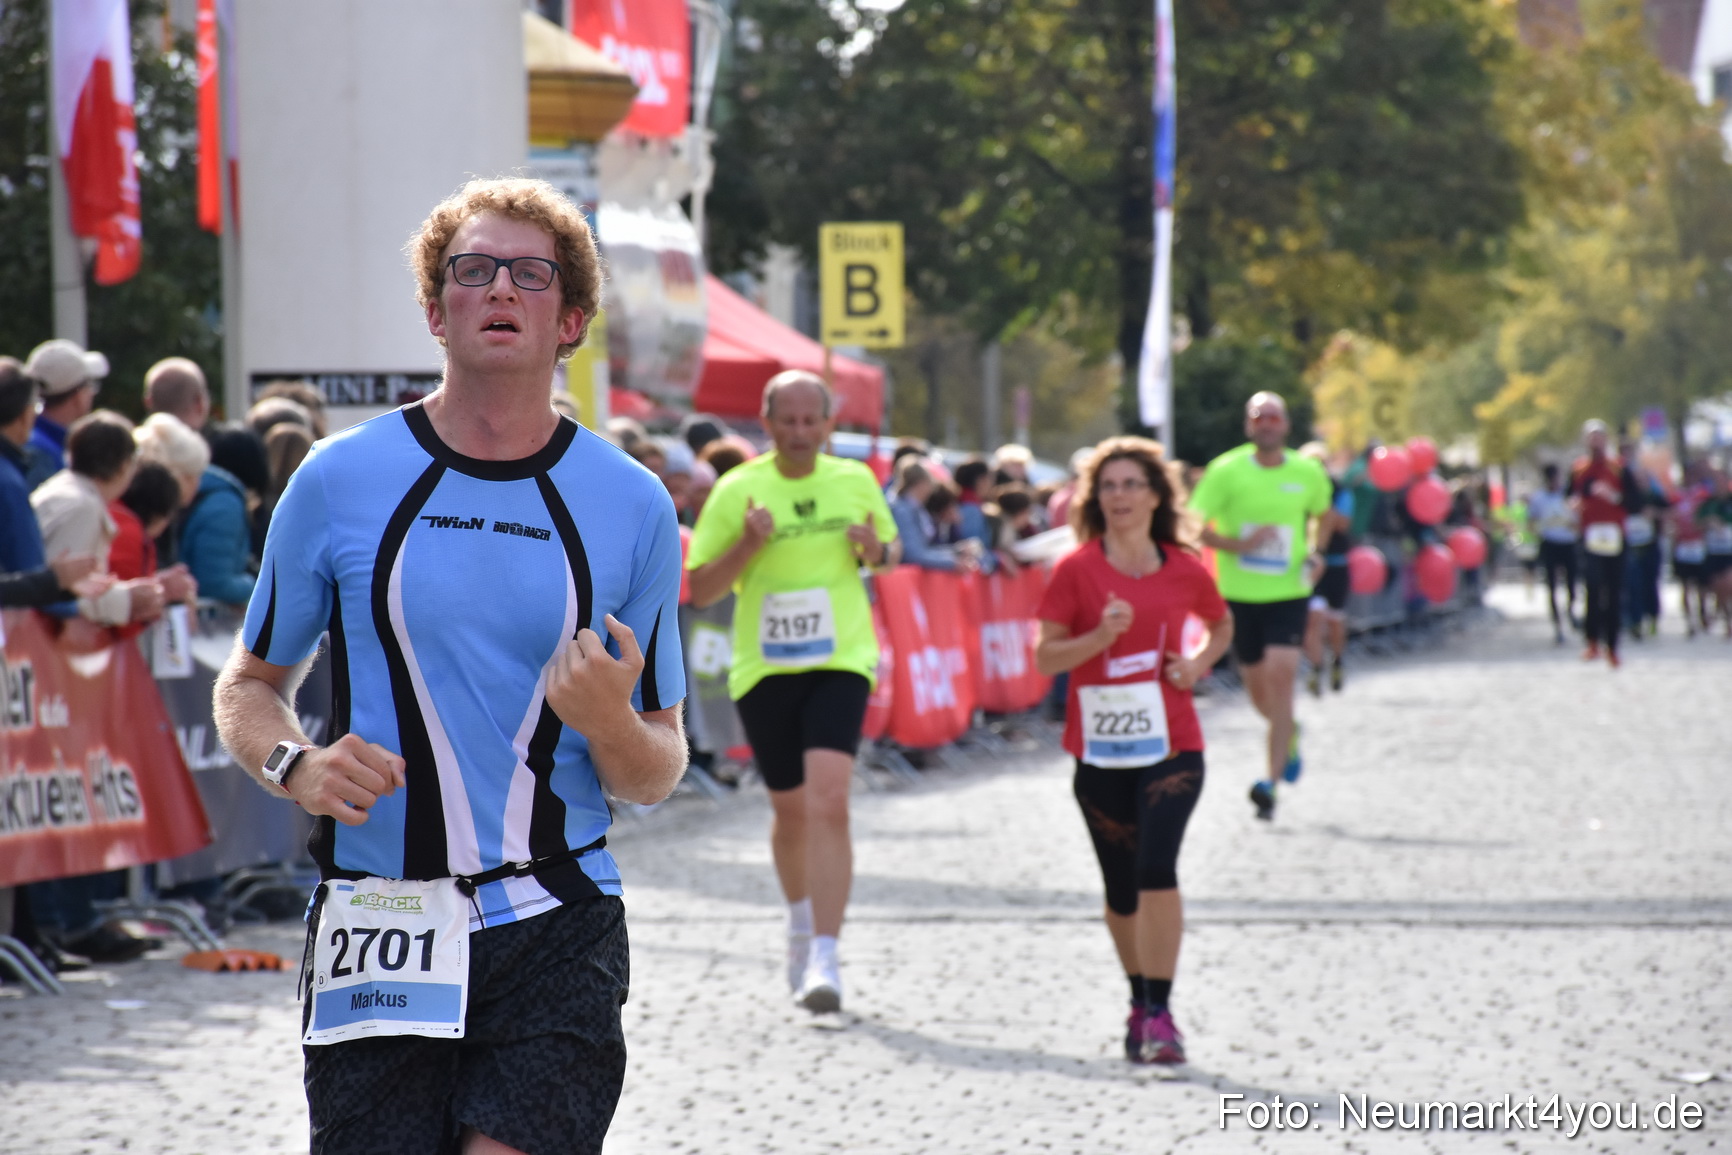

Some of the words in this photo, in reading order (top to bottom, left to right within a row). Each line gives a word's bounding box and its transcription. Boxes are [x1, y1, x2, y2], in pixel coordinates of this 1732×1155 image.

[845, 263, 880, 317] B
[765, 611, 823, 639] 2197
[1092, 708, 1152, 736] 2225
[331, 927, 436, 979] 2701
[350, 989, 408, 1011] Markus
